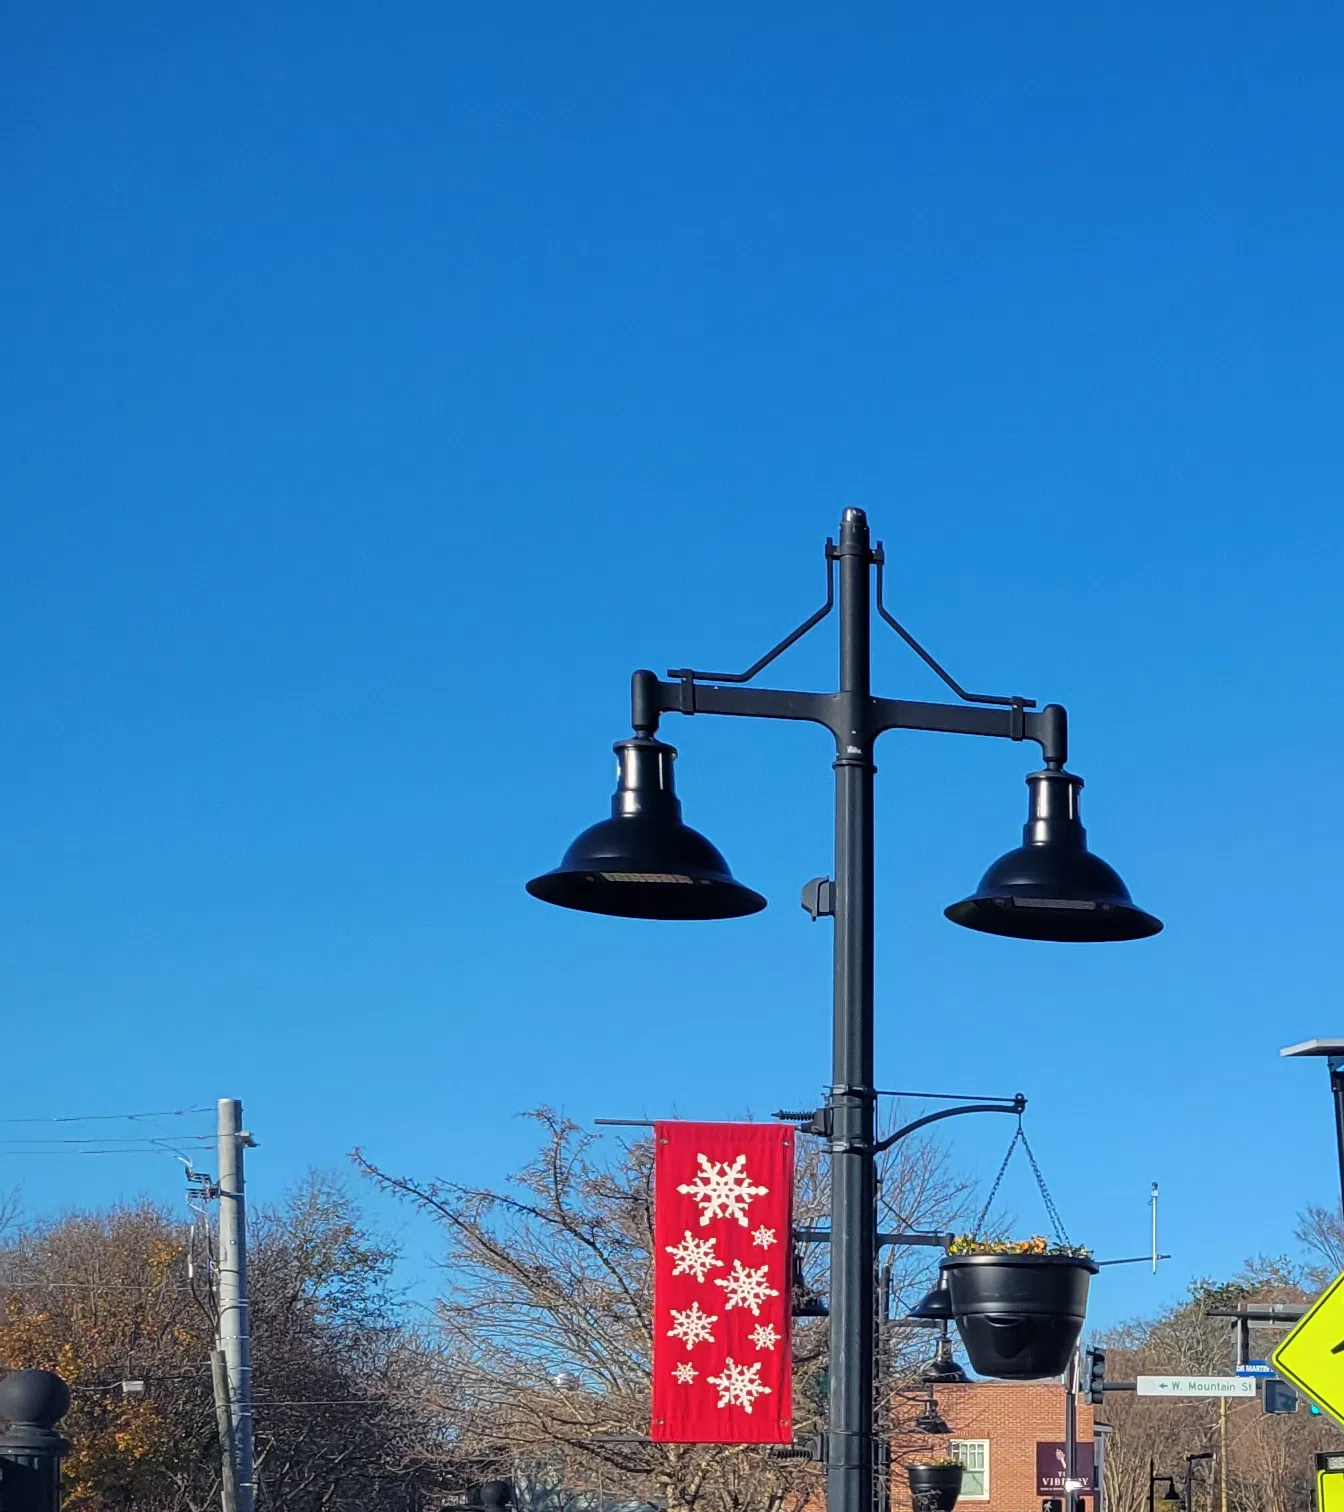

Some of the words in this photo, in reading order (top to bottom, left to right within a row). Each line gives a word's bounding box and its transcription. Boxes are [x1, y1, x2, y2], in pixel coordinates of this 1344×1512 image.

[1246, 1364, 1270, 1373] MARTIN
[1171, 1381, 1183, 1391] W.
[1188, 1381, 1236, 1391] Mountain
[1241, 1382, 1253, 1391] St
